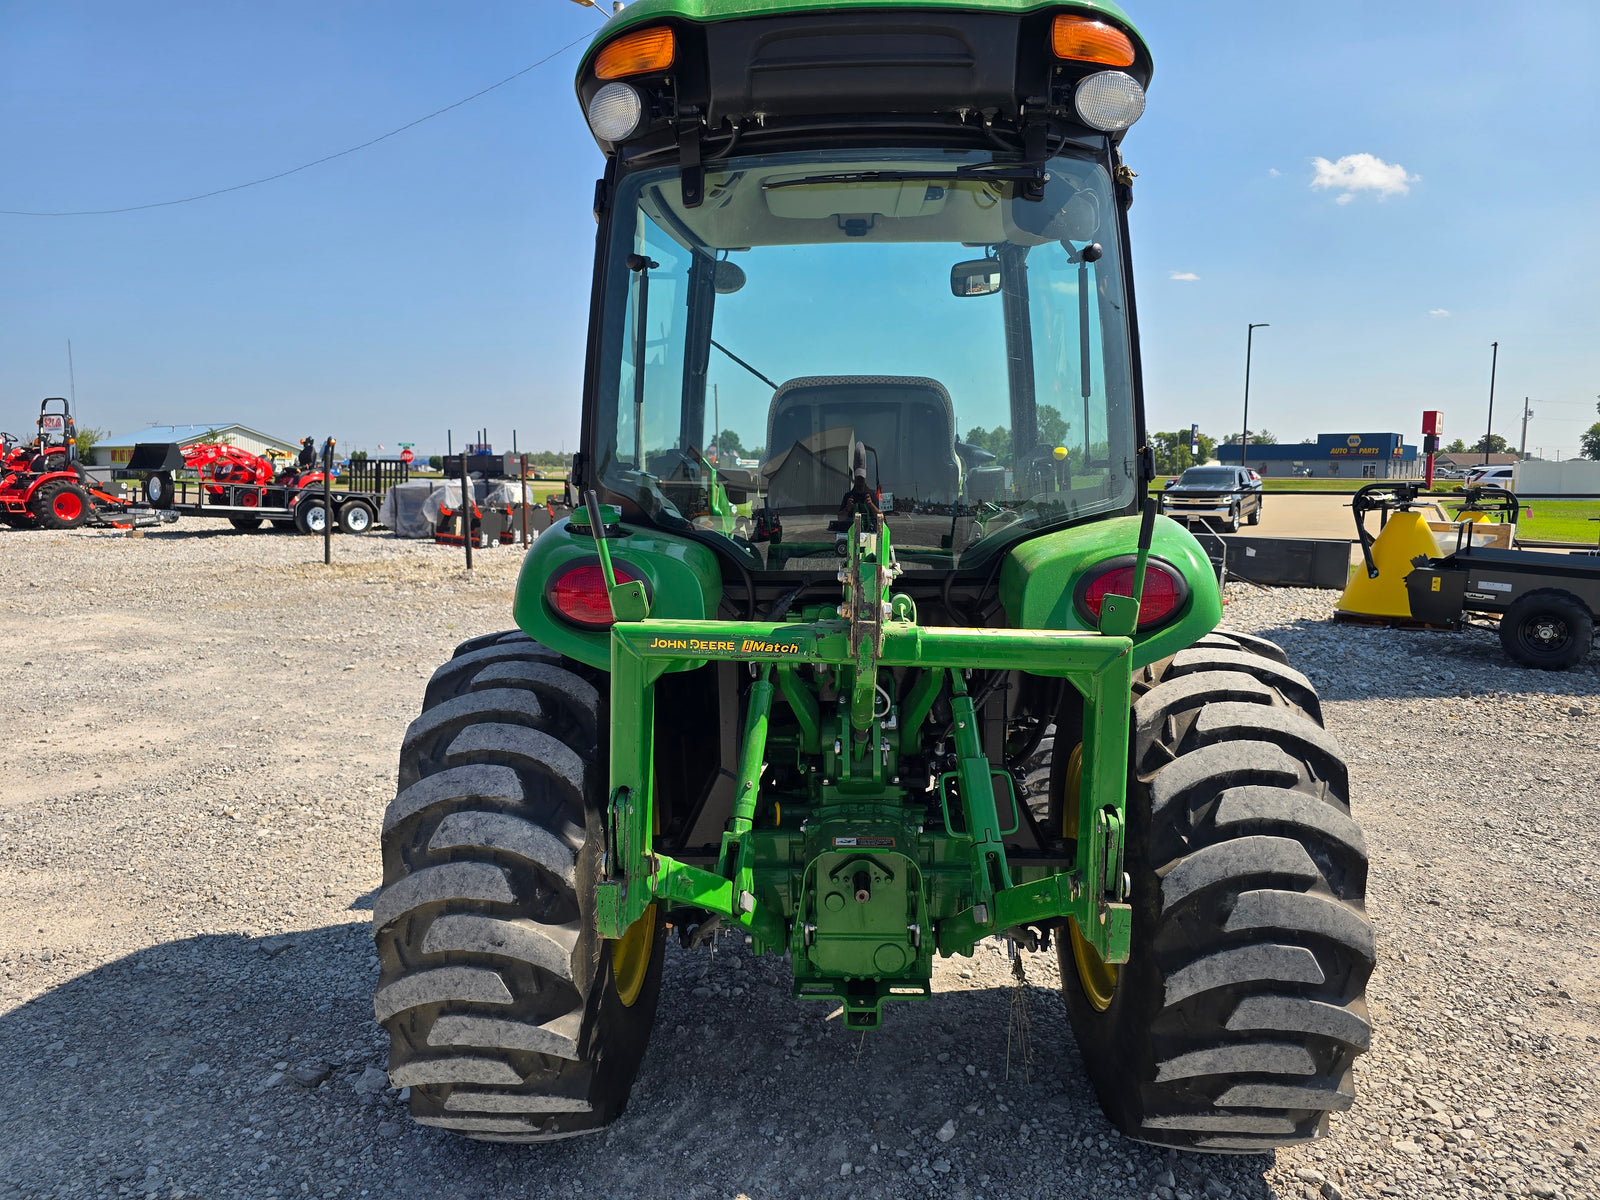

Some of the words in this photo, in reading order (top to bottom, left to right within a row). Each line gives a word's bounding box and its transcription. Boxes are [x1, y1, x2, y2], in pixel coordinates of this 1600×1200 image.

[1330, 447, 1348, 455] AUTO
[1358, 447, 1379, 455] PARTS
[650, 637, 687, 649] JOHN
[690, 639, 735, 651] DEERE
